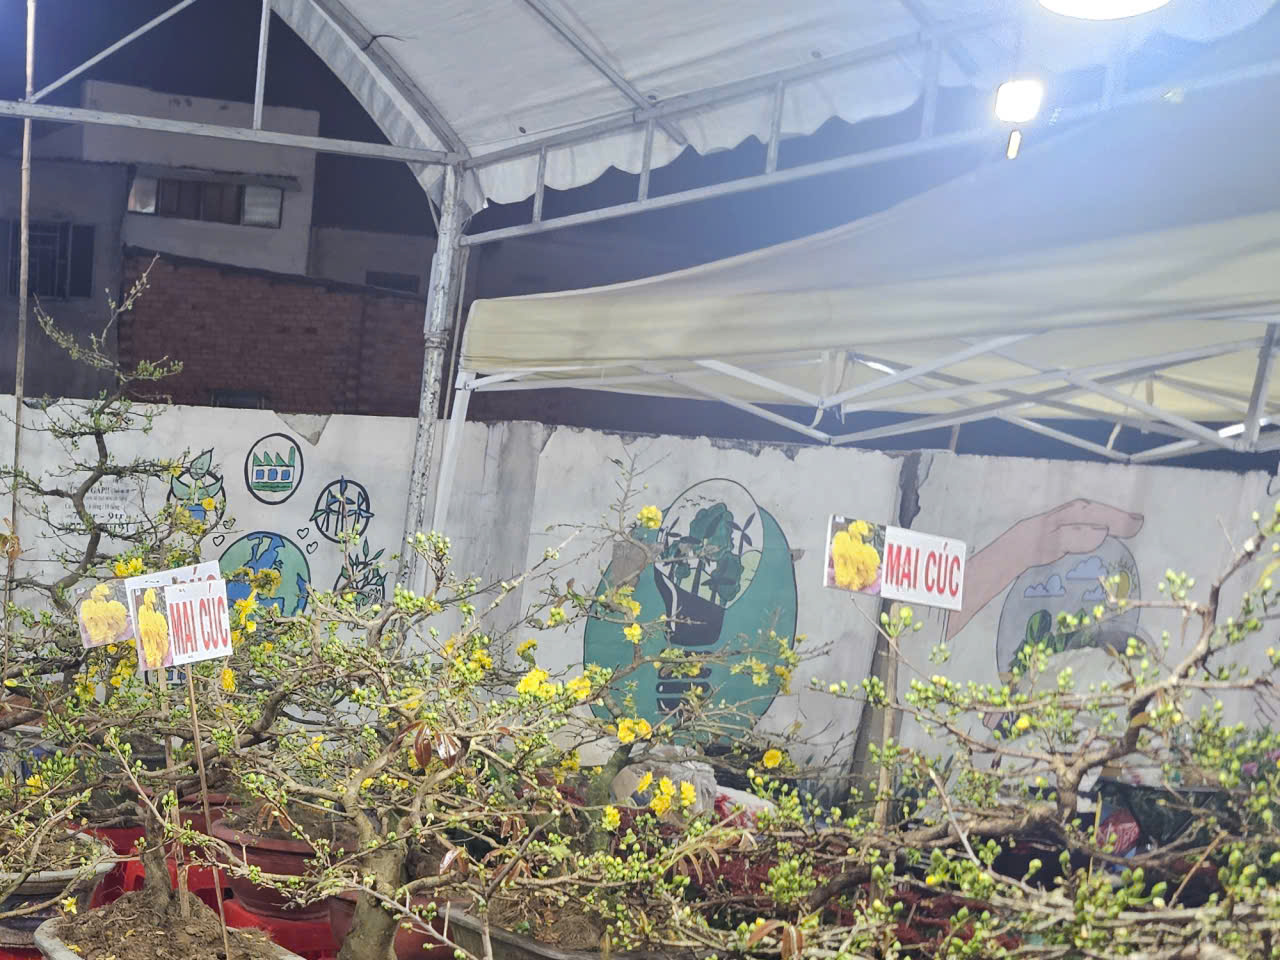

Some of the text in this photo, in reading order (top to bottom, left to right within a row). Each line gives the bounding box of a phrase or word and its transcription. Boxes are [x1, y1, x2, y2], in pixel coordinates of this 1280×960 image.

[885, 541, 960, 597] MAI CÚC
[169, 583, 228, 656] MAI CÚC
